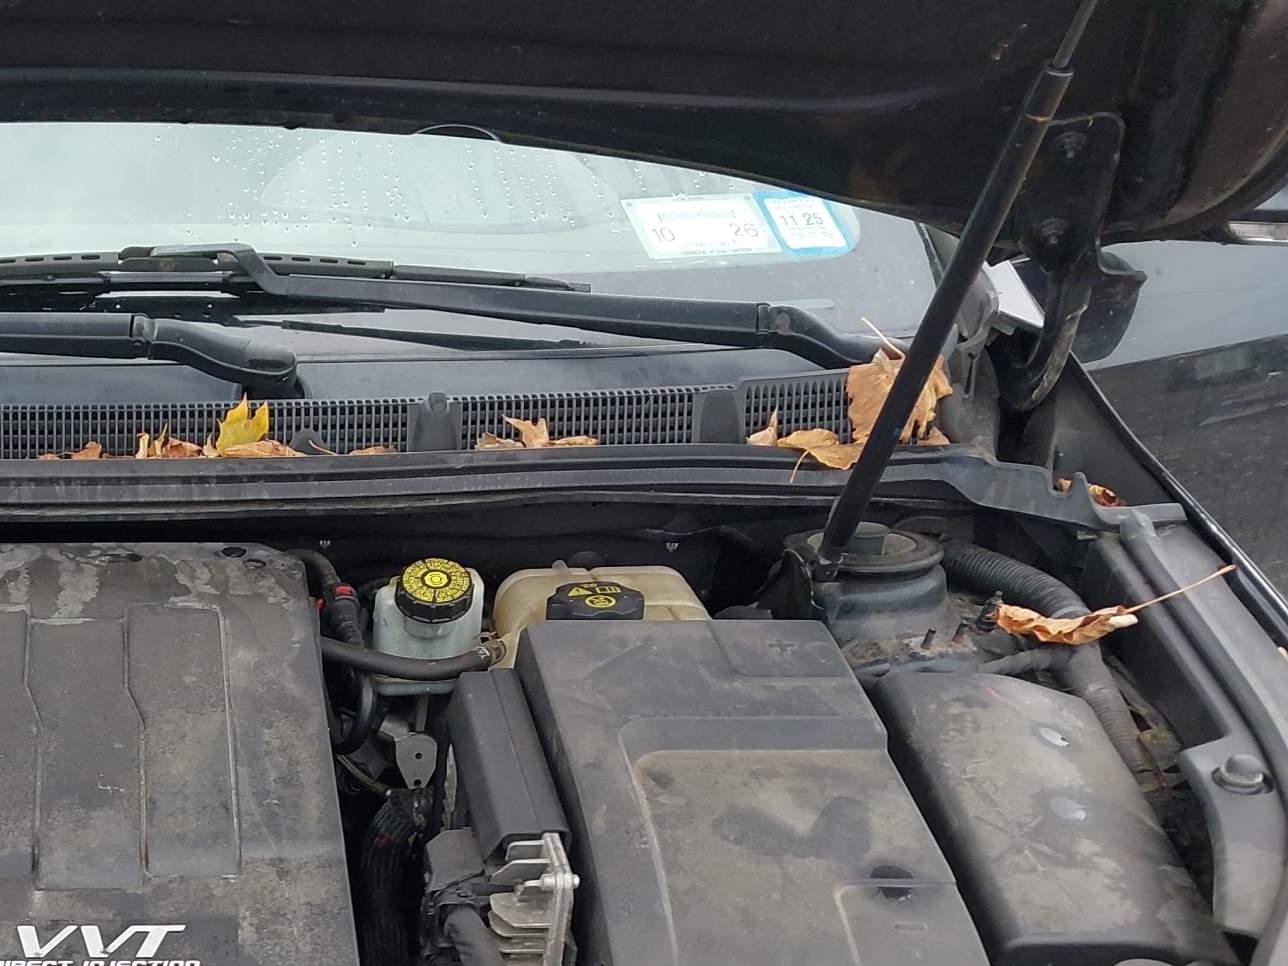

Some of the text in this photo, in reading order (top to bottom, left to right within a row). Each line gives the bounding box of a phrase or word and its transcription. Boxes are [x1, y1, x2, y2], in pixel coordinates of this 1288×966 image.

[802, 211, 824, 226] 25
[652, 222, 760, 243] 10 26
[17, 925, 186, 958] VVT
